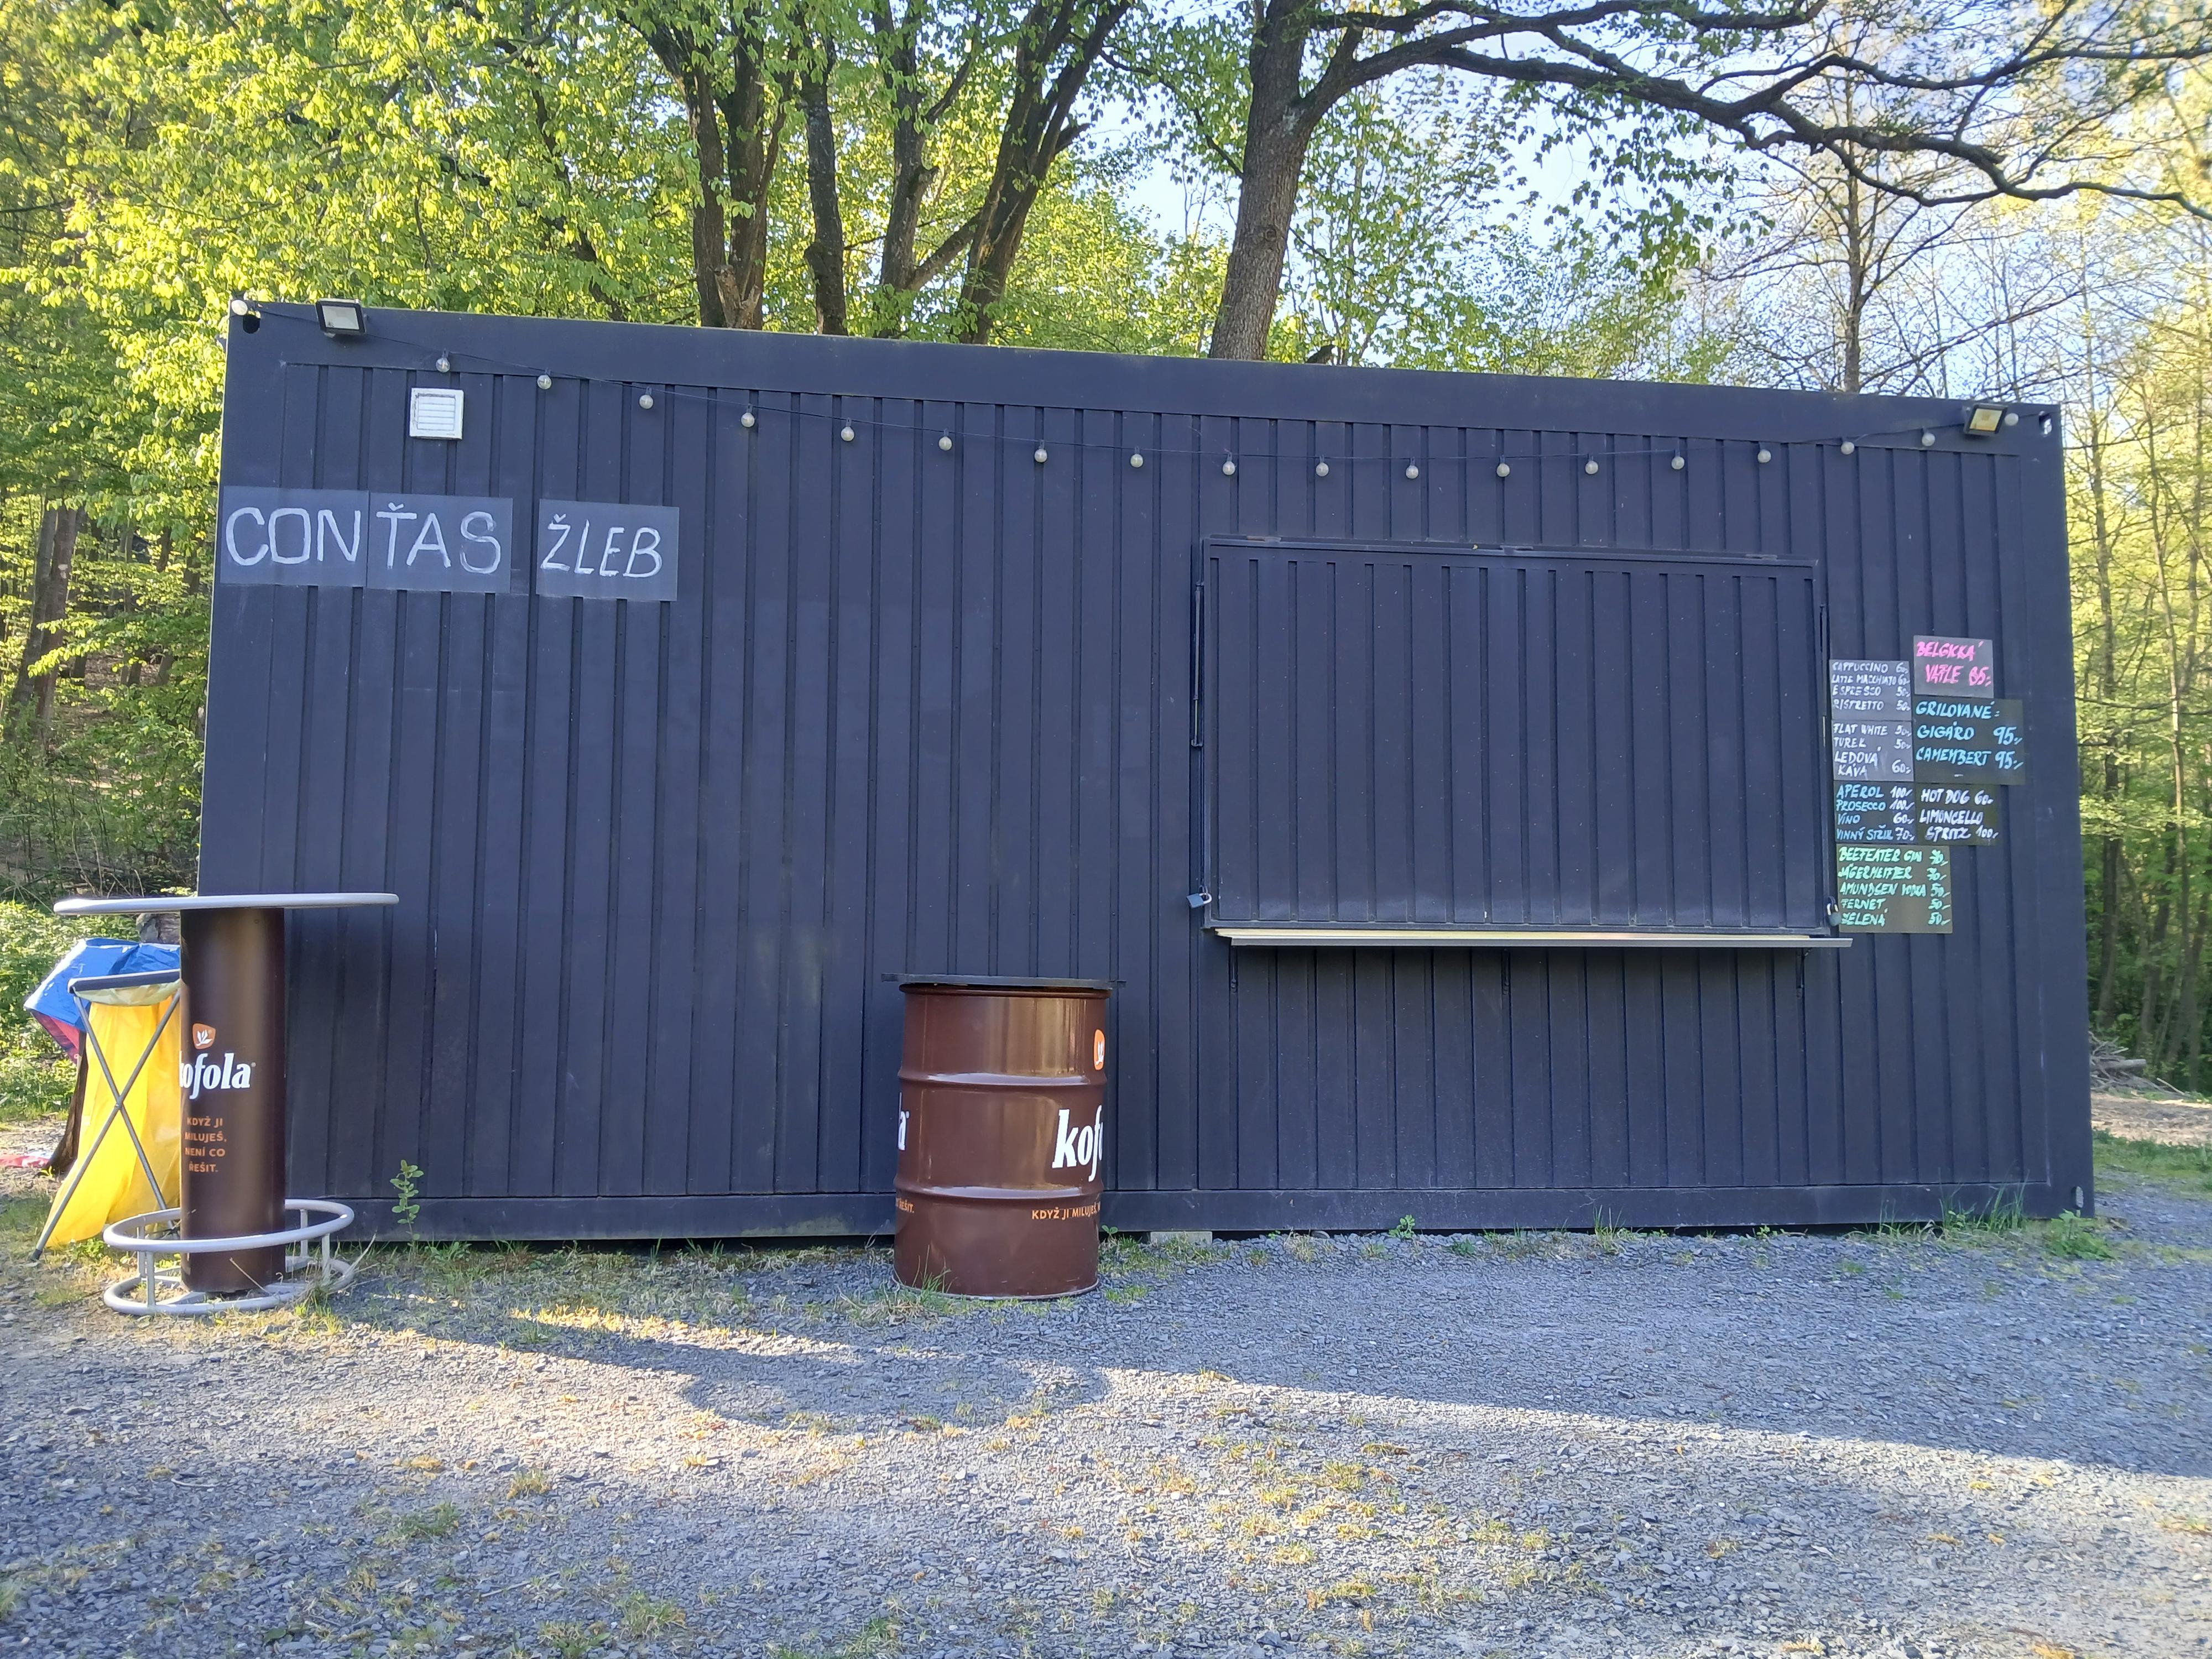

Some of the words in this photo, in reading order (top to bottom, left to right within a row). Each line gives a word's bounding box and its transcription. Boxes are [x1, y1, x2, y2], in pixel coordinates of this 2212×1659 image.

[540, 513, 663, 578] ŽLEB
[1832, 662, 1888, 673] CAPPUCCINO
[1832, 685, 1881, 696] ESPRESSO
[1833, 698, 1884, 711] RISTRETTO
[1833, 723, 1858, 734] FLAT
[1861, 724, 1888, 735] WHITE
[1833, 737, 1866, 748] TUREK
[1834, 746, 1881, 768] LEDOVÁ
[1916, 747, 1992, 766] CAMEMBERT
[1838, 763, 1867, 777] KÁVA
[1836, 784, 1885, 800] APEROL
[1921, 788, 1944, 802] HOT
[1945, 789, 1970, 805] DOG
[1836, 799, 1886, 811] PROSECCO
[1838, 812, 1861, 825] VÍNO
[1919, 808, 1984, 825] LIMONCELLO
[1836, 826, 1866, 841] VINNÝ
[1924, 826, 1972, 842] SPRITZ
[1839, 847, 1901, 862] BEEFEATER
[1903, 850, 1923, 862] GIN
[1839, 881, 1898, 897] AMUNDSEN
[1840, 898, 1886, 910] FERNET
[1841, 907, 1888, 927] ZELENÁ
[186, 1116, 211, 1126] KDYŽ
[213, 1118, 223, 1128] JI
[185, 1147, 205, 1156] NENÍ
[208, 1149, 226, 1157] CO
[1032, 1207, 1060, 1219] KDYŽ
[1061, 1209, 1070, 1220] JI
